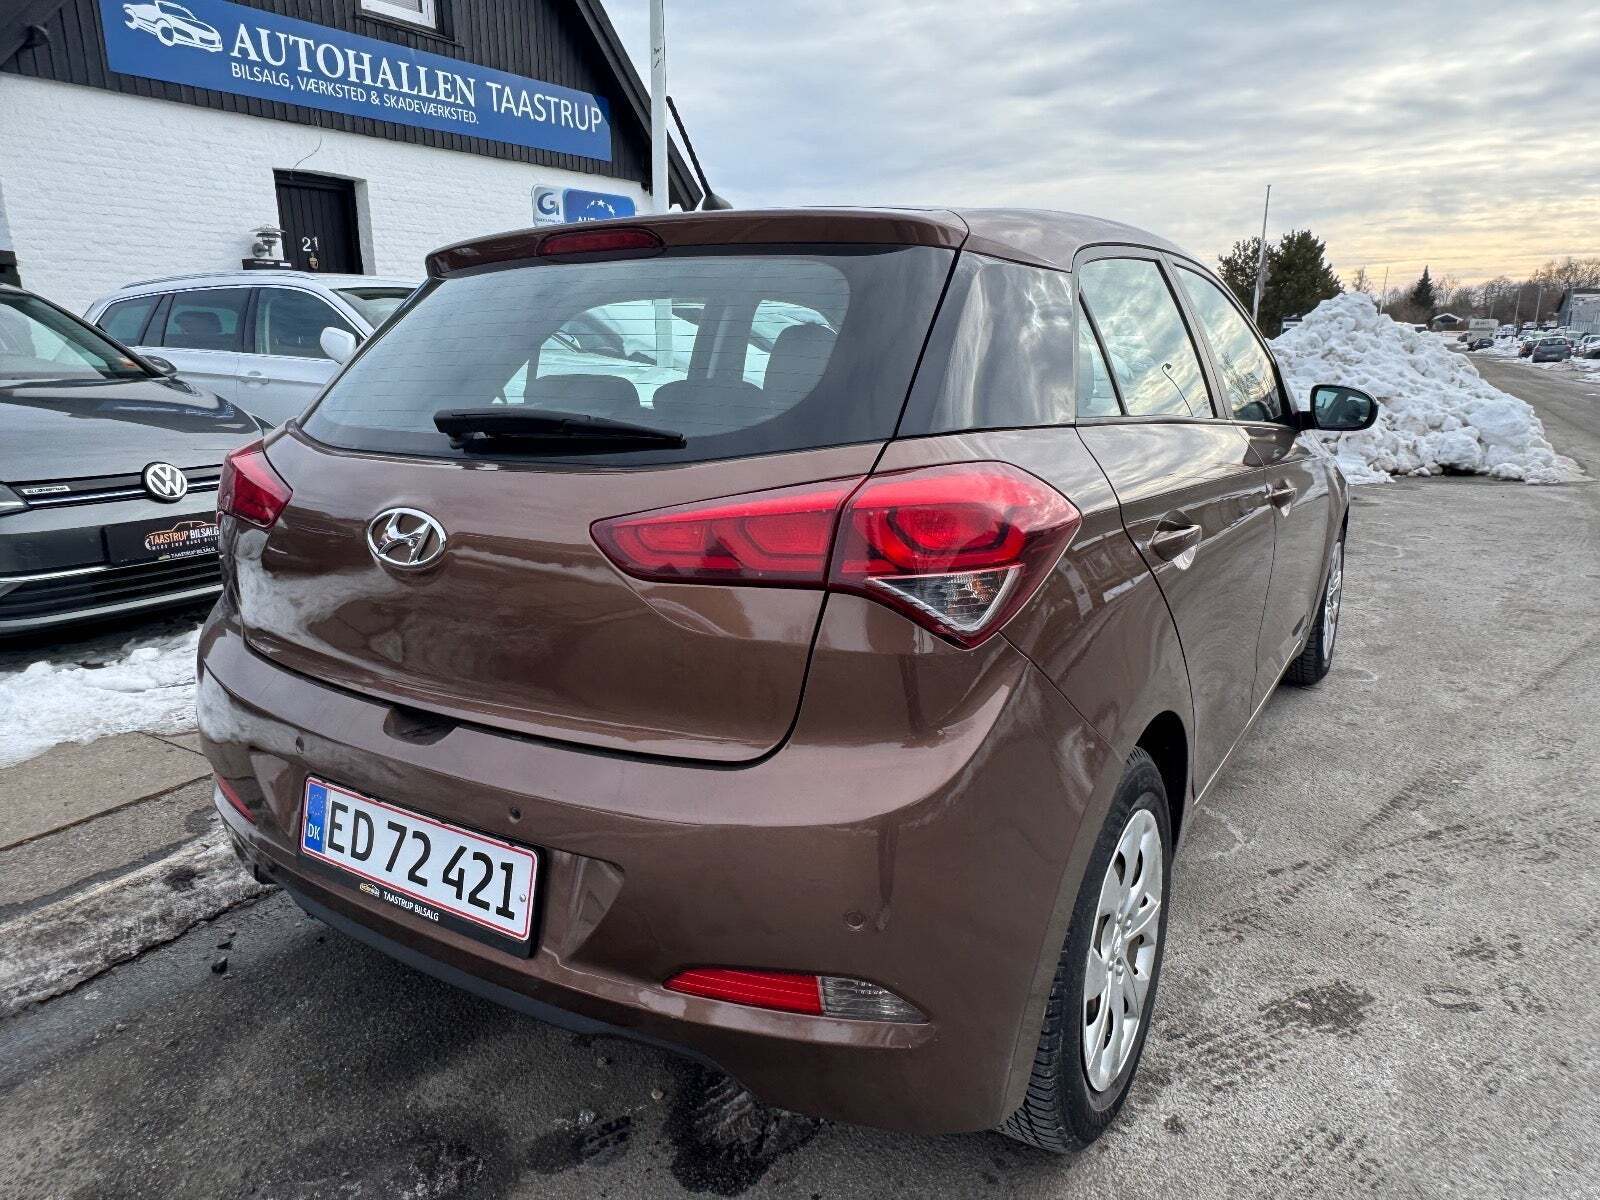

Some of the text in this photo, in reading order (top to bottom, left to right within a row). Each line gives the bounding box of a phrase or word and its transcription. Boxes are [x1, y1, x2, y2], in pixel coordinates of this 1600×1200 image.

[229, 23, 602, 133] AUTOHALLEN TAASTRUP
[231, 62, 479, 125] BILSALG, VÆRKSTED & SKADEVÆRKSTED.
[302, 236, 319, 252] 21
[150, 530, 188, 545] TAASTRUP
[190, 526, 219, 540] BILSALG
[307, 823, 320, 841] DK
[327, 800, 515, 920] ED 72 421
[383, 891, 439, 921] TAASTRUP BILSALG
